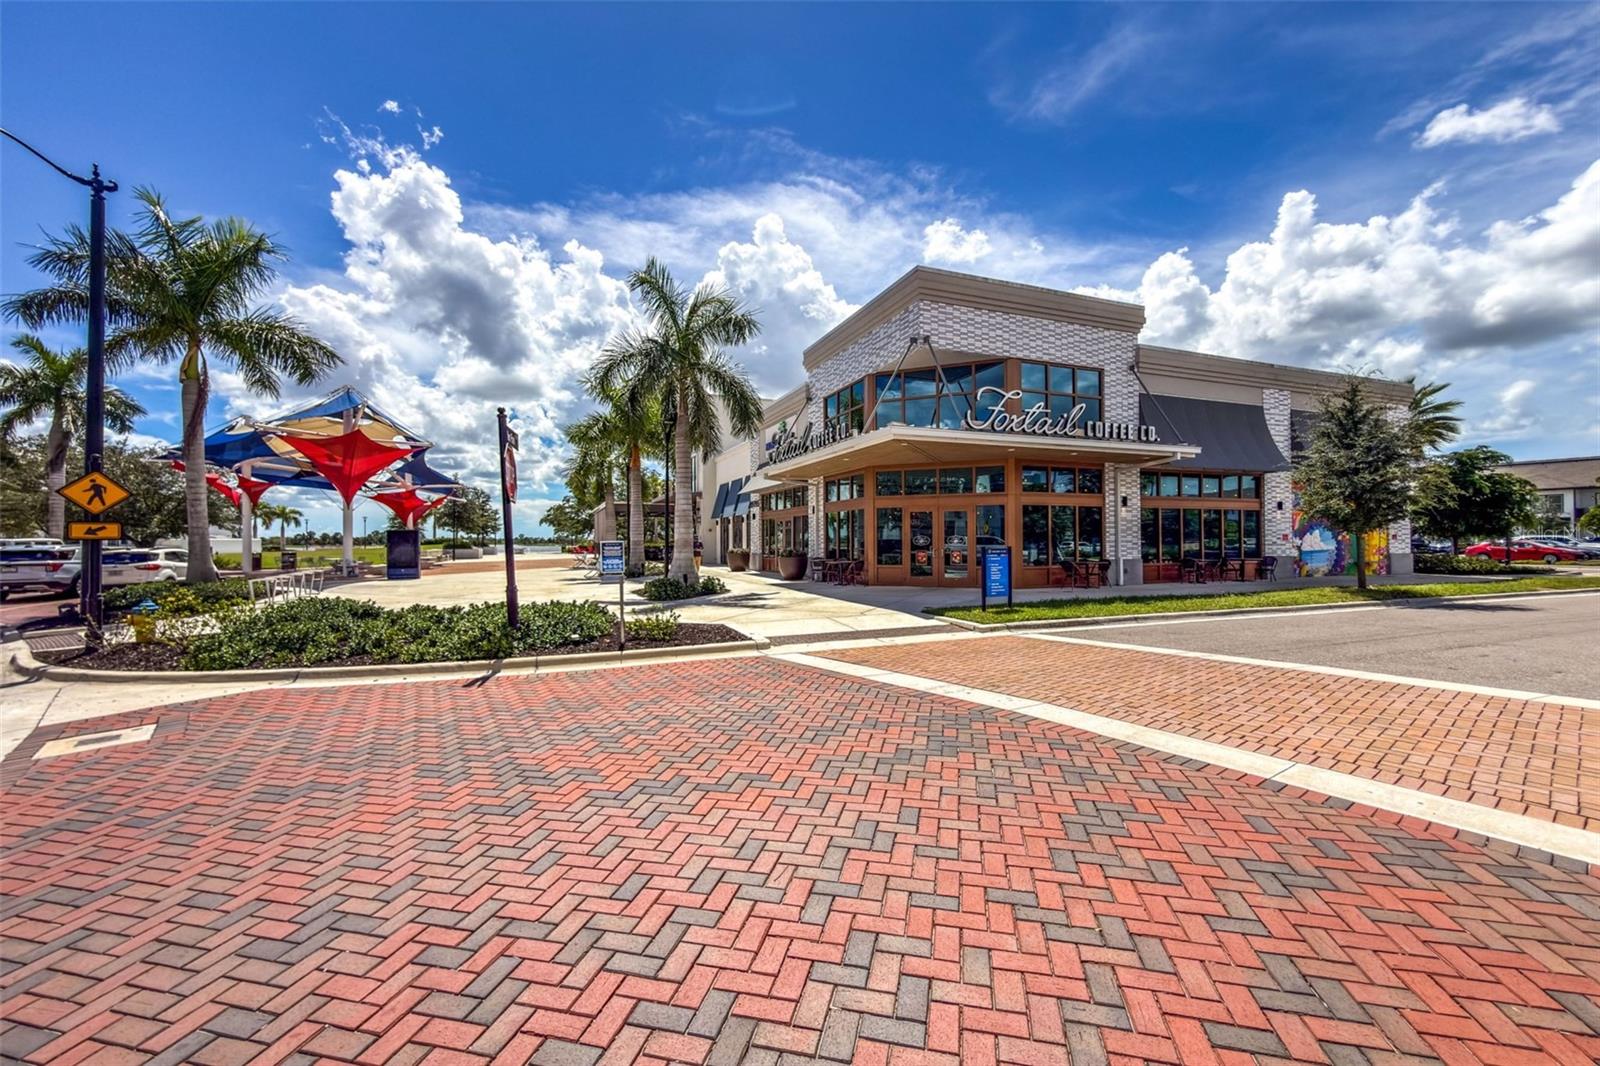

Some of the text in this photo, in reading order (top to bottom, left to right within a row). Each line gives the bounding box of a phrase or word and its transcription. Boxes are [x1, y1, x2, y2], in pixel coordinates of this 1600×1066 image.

[967, 386, 1161, 442] Foxtail COFFEE CO.
